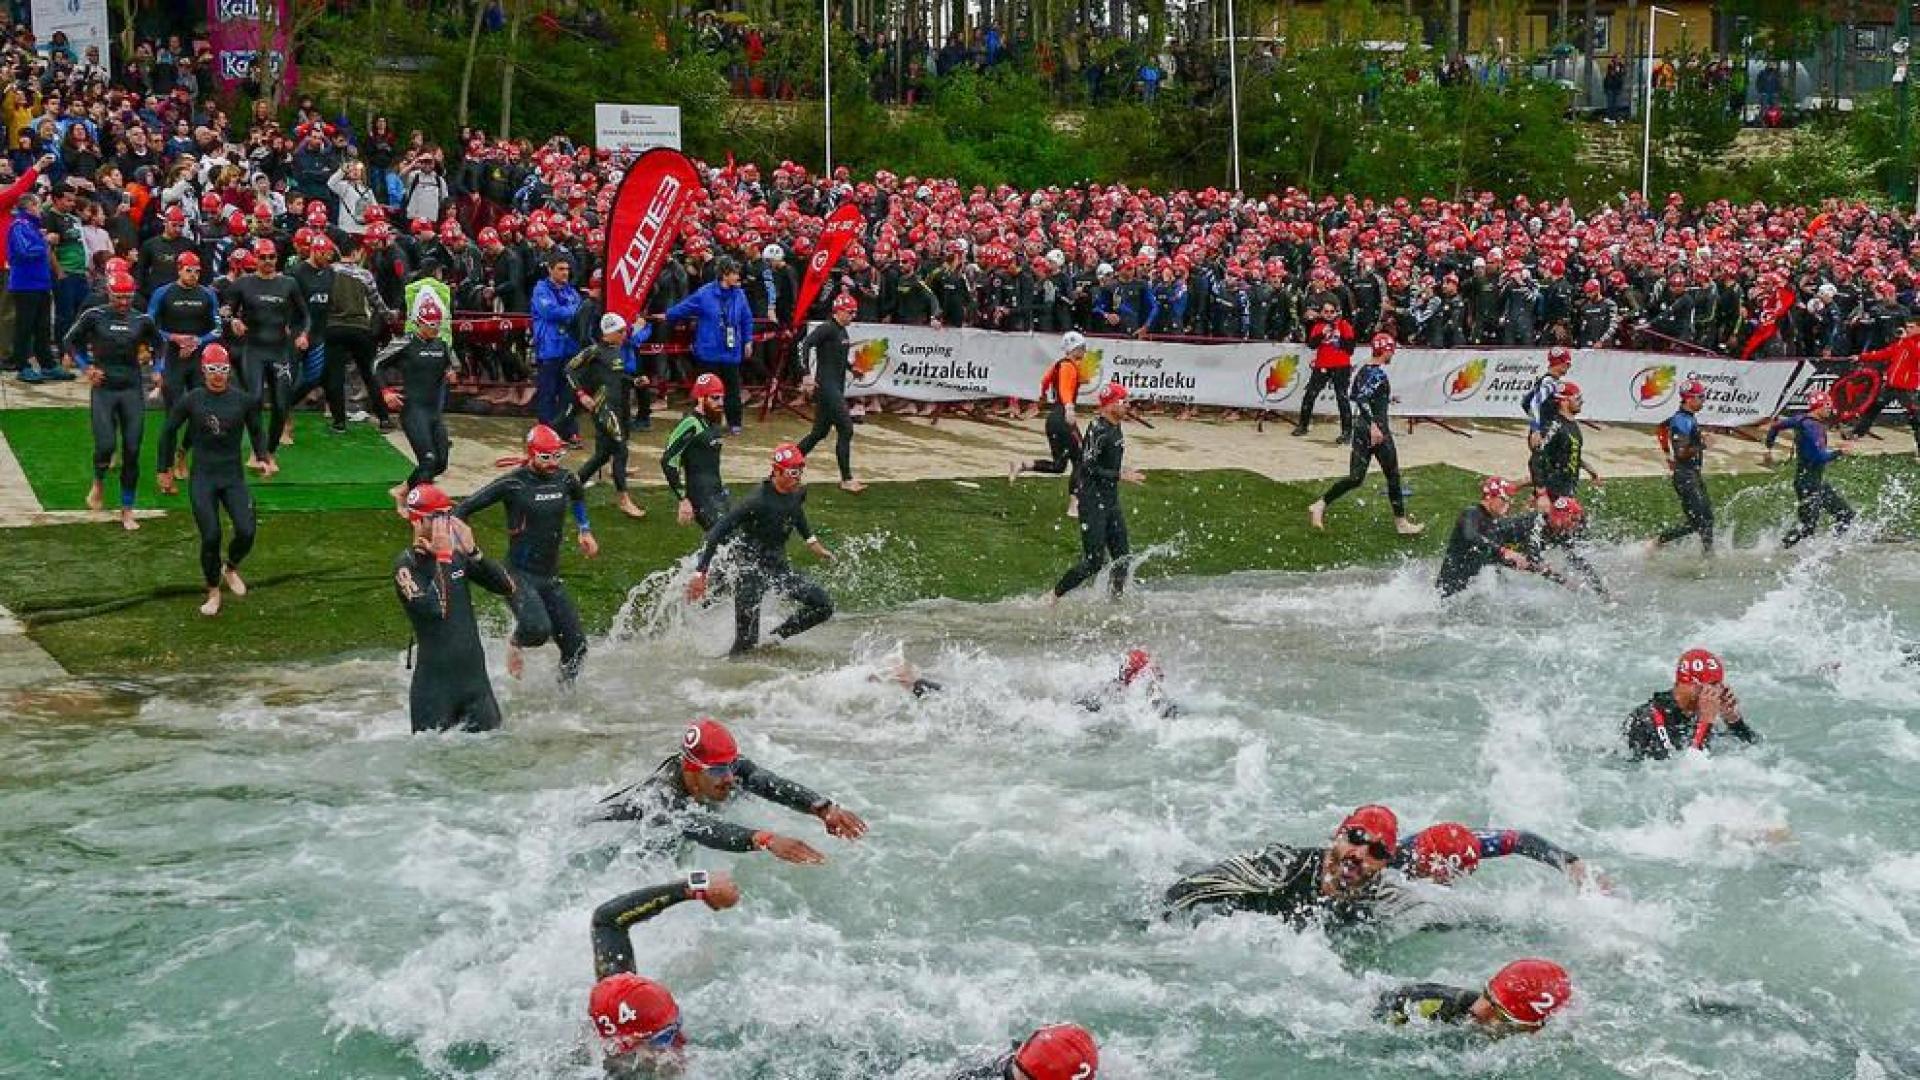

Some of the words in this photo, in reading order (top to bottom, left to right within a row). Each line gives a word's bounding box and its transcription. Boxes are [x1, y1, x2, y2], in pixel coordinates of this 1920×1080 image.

[900, 343, 953, 357] Camping
[1113, 355, 1163, 368] Camping
[1495, 362, 1540, 375] Camping
[893, 361, 989, 379] Aritzaleku
[1111, 372, 1196, 389] Aritzaleku
